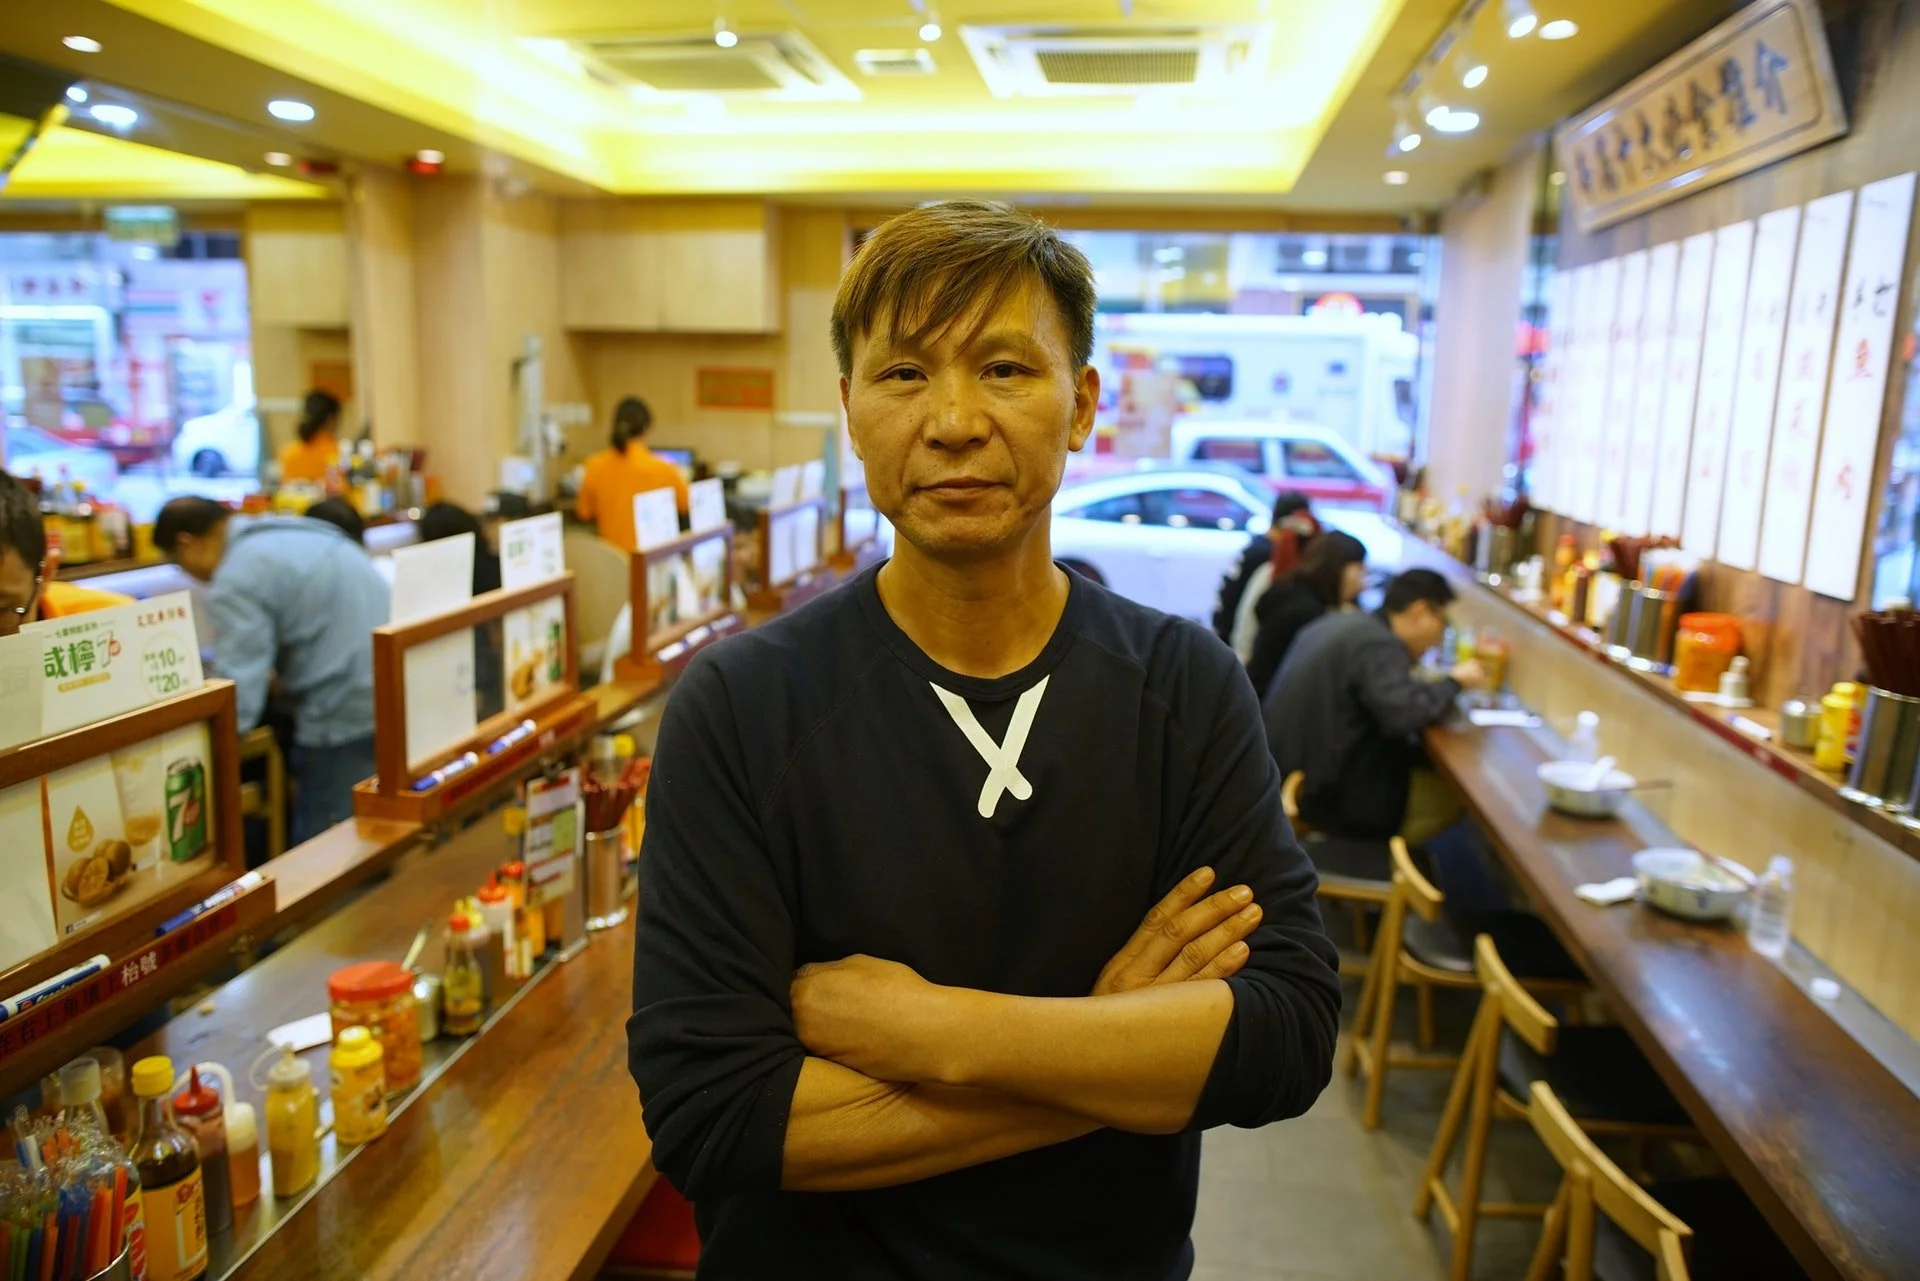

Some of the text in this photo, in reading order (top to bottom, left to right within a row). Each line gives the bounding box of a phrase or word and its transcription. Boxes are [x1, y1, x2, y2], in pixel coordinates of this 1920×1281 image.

[158, 648, 176, 668] 10
[162, 672, 180, 692] 20
[121, 951, 158, 987] 枱號
